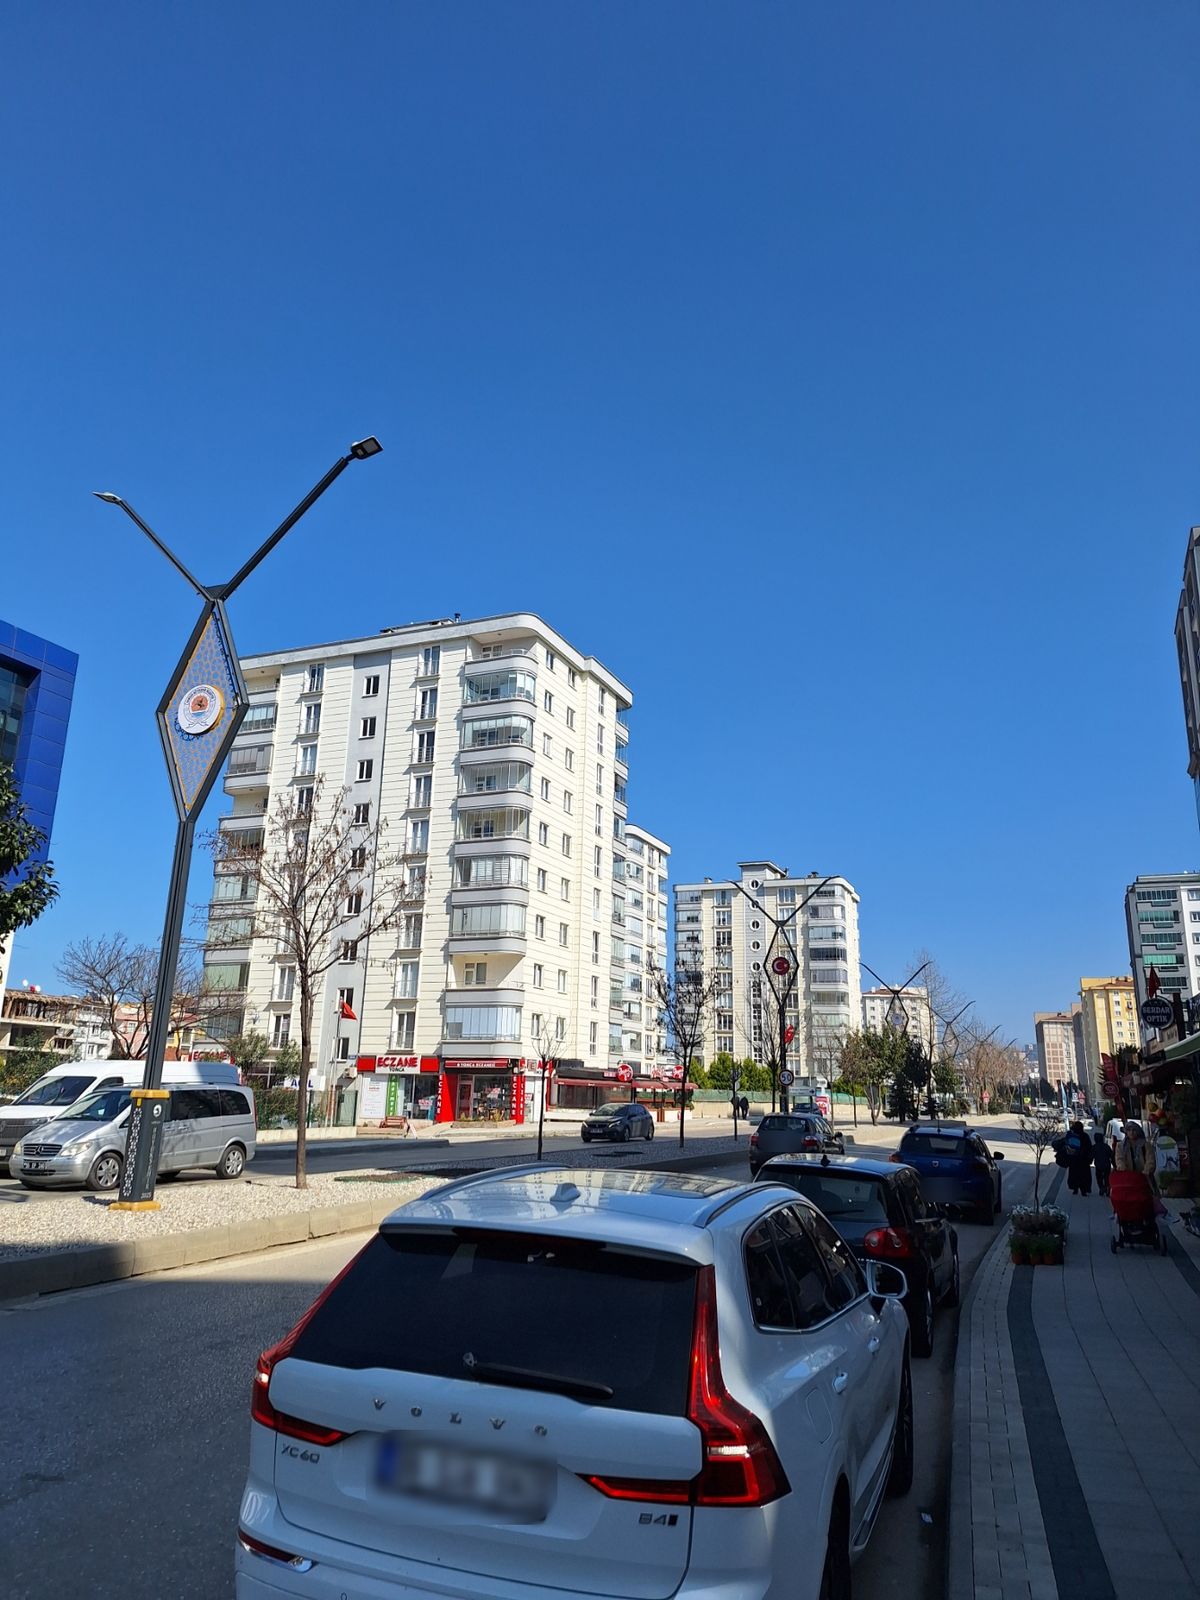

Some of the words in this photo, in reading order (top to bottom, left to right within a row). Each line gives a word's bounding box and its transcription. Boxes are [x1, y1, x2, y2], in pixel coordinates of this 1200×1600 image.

[1142, 1006, 1170, 1014] SERDAR
[377, 1057, 418, 1067] ECZANE
[781, 1073, 791, 1082] 50
[373, 1398, 548, 1437] VOLVO
[281, 1443, 321, 1464] XC60
[639, 1513, 667, 1526] B4
